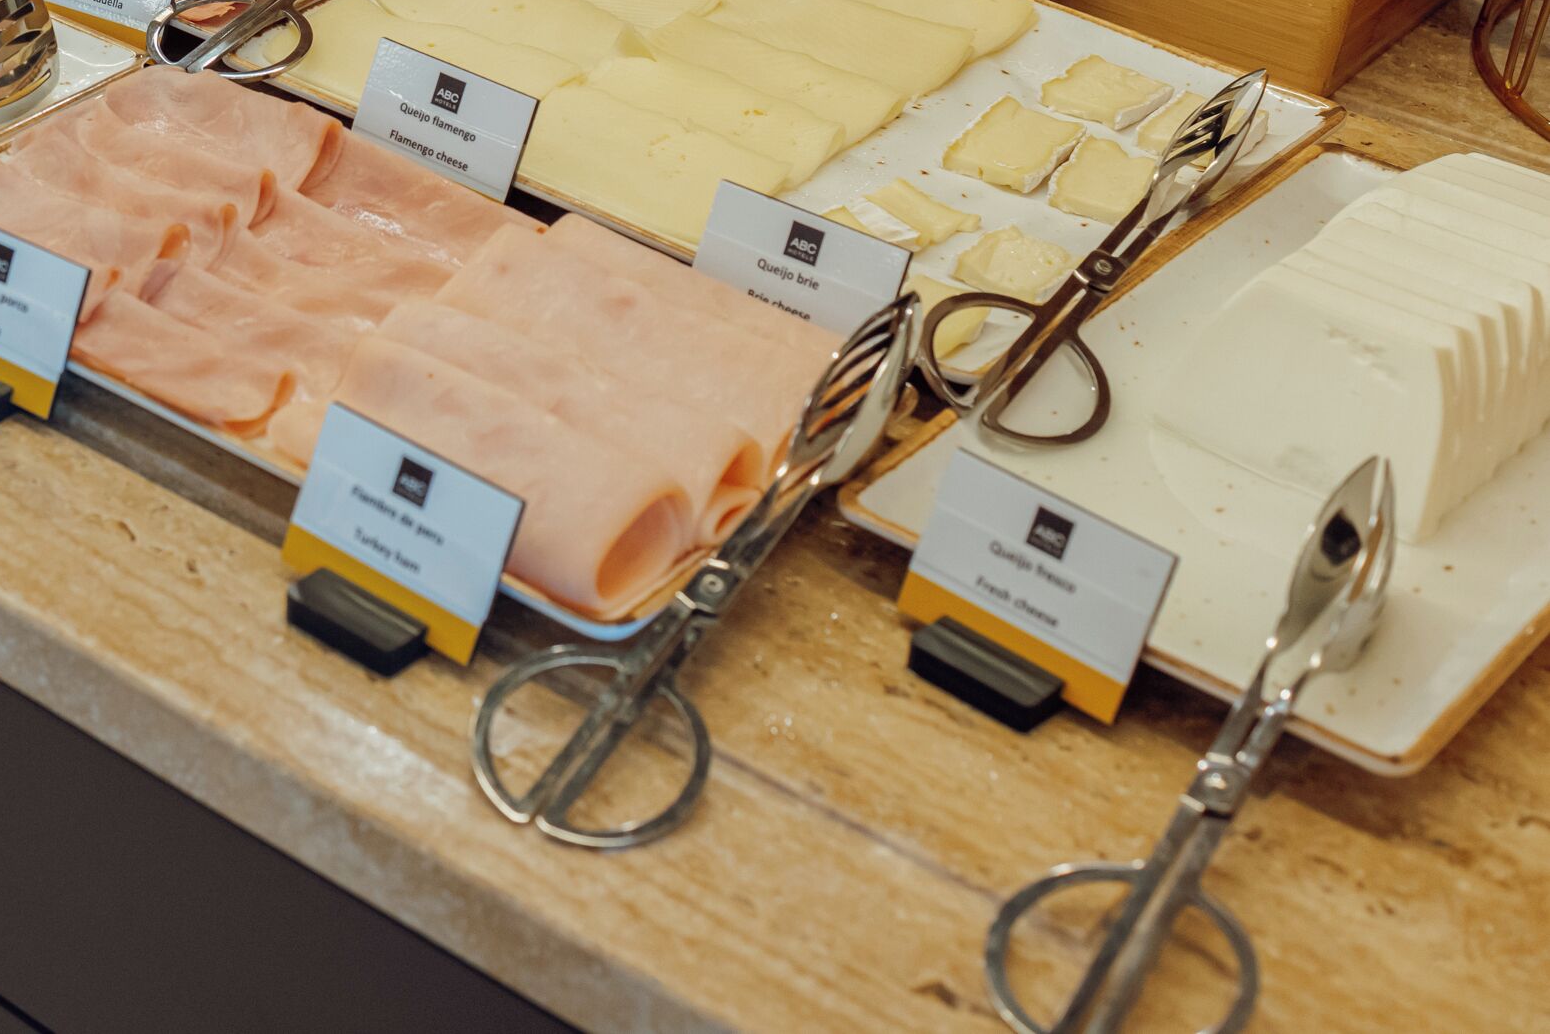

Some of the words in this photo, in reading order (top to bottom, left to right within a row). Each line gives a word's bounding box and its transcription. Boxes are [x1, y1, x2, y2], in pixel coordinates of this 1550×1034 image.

[434, 98, 456, 110] HOTELS
[437, 87, 459, 103] ABC
[400, 102, 430, 123] Queijo
[432, 115, 476, 142] flamengo
[389, 129, 434, 157] Flamengo
[436, 151, 469, 172] cheese
[787, 248, 814, 262] HOTELS
[790, 237, 818, 255] ABC
[757, 258, 794, 280] Queijo
[796, 272, 820, 291] brie
[0, 294, 29, 313] porco
[351, 485, 396, 519] Fiambre
[399, 513, 413, 528] de
[416, 523, 444, 547] peru
[354, 527, 392, 560] Turkey
[394, 550, 421, 574] ham
[1035, 524, 1067, 548] ABC
[988, 540, 1033, 572] Queijo
[1036, 563, 1077, 594] fresco
[975, 574, 1011, 602] Fresh
[1014, 597, 1059, 627] cheese
